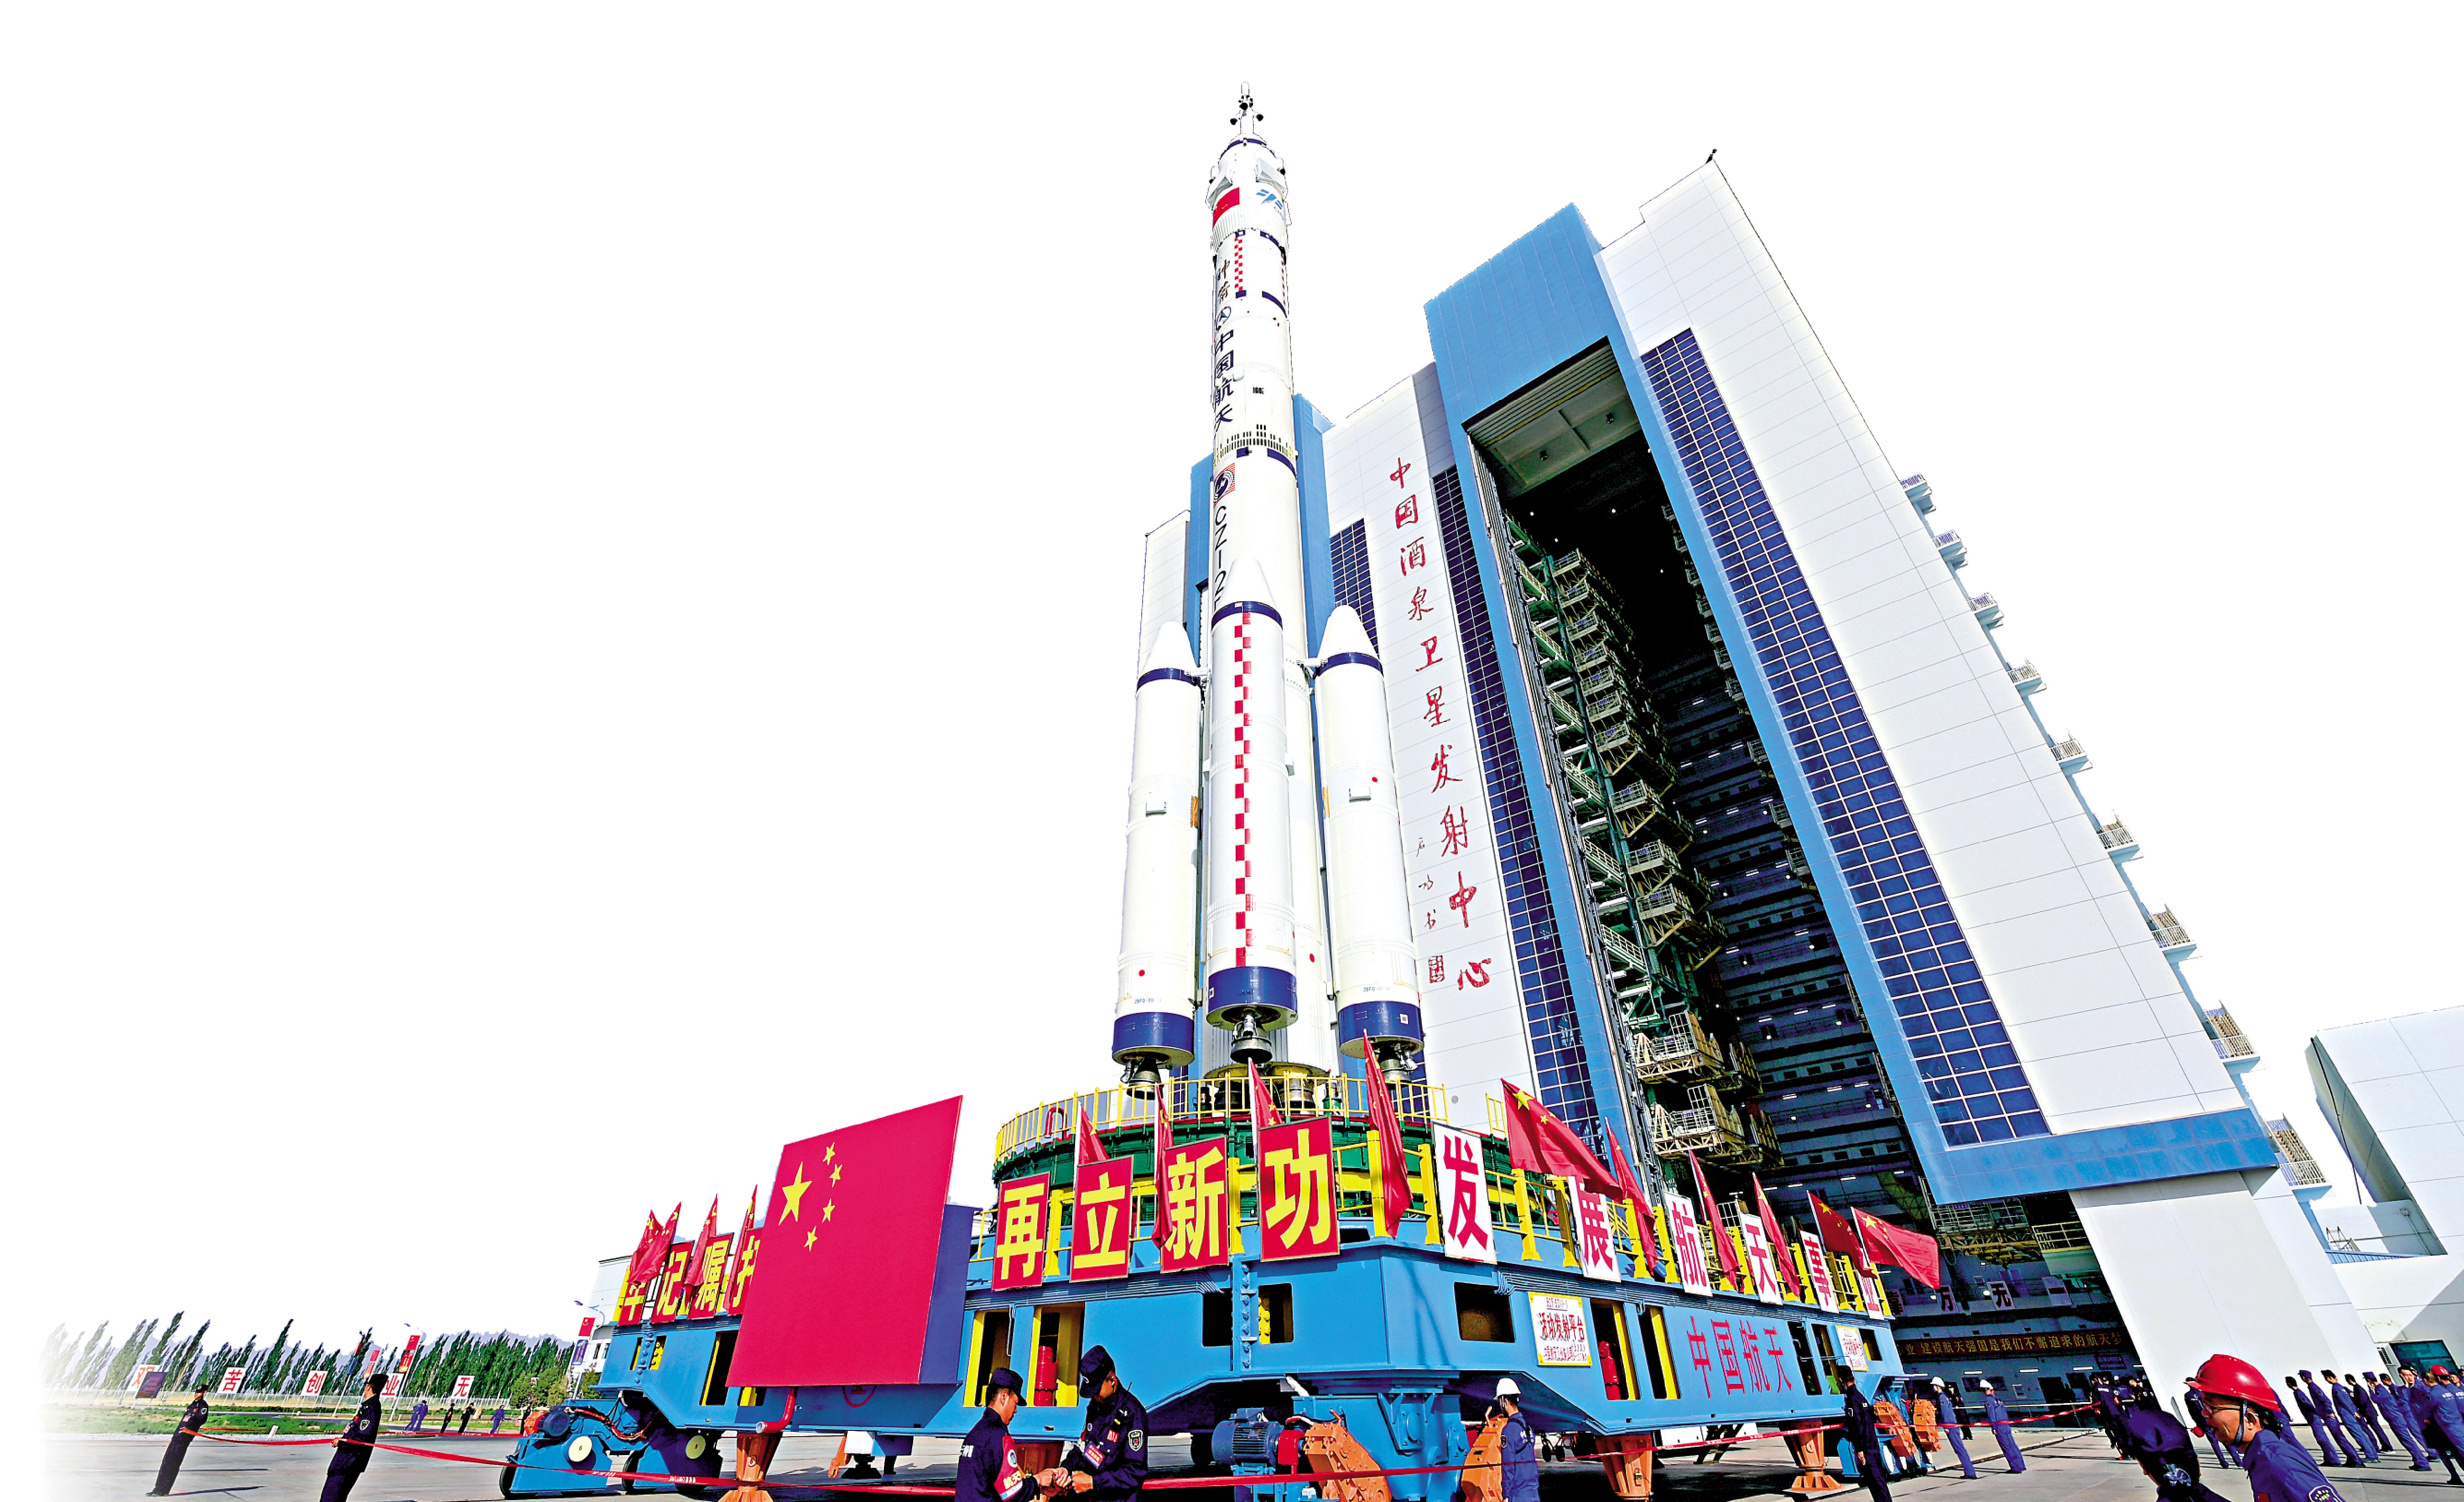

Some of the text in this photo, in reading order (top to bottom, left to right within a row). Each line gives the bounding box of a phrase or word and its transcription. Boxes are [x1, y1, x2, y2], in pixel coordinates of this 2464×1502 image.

[1215, 329, 1233, 433] 中国航天
[1390, 458, 1492, 991] 中国酒泉卫星发射中心
[1687, 1316, 1792, 1399] 中国航天
